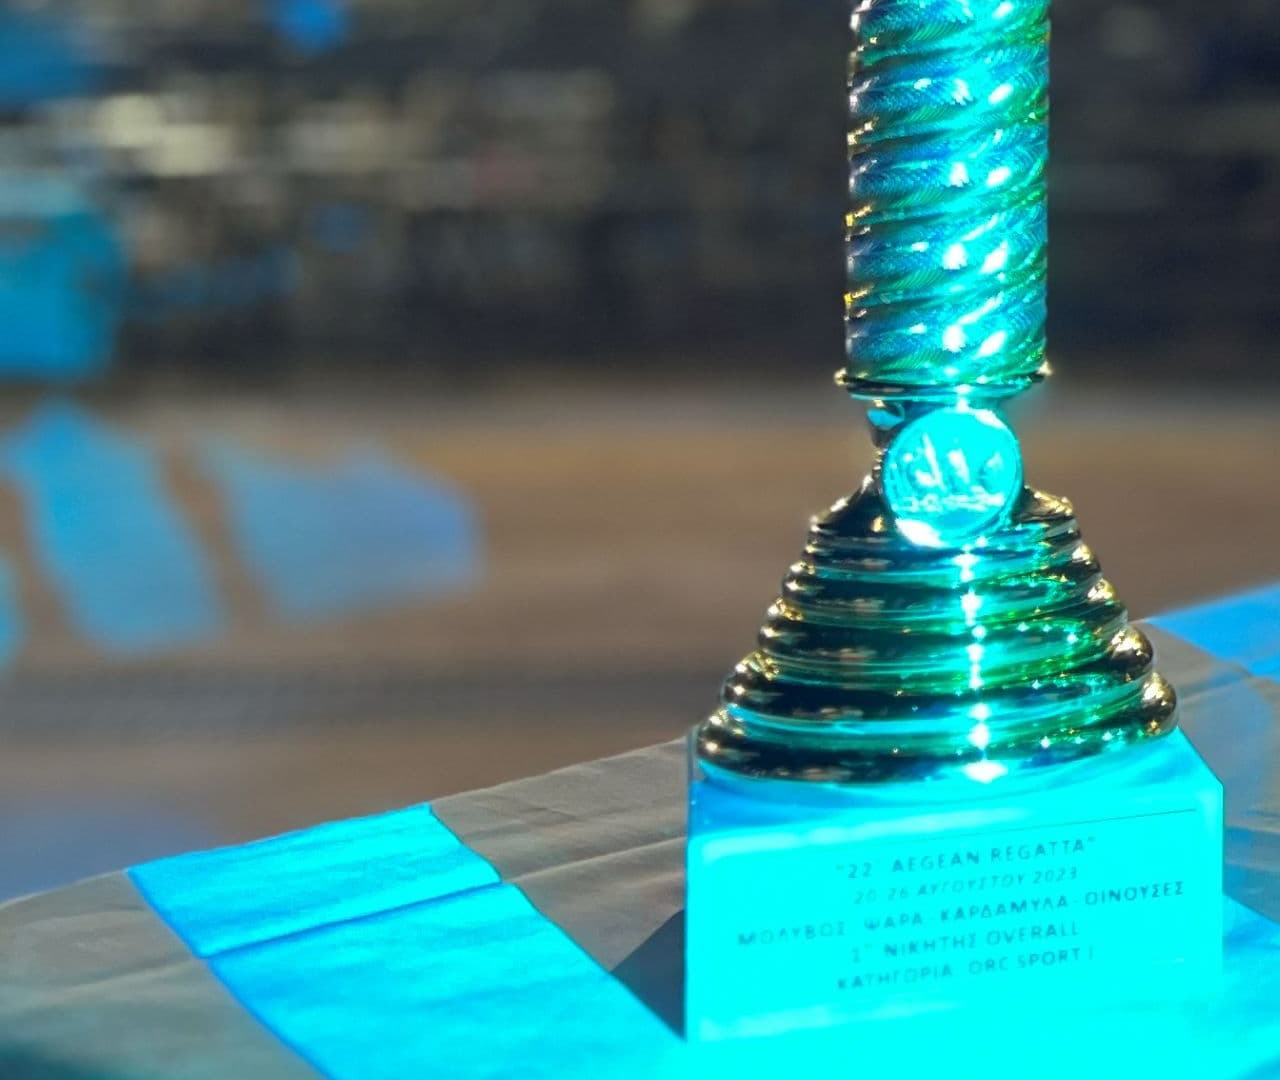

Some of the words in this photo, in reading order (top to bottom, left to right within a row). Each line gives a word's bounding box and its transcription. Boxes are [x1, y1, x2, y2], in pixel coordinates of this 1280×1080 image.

[892, 851, 980, 873] AEGEAN
[1032, 866, 1078, 884] 2023
[986, 920, 1080, 945] OVERALL
[968, 956, 1009, 974] ORC
[1017, 947, 1081, 968] SPORT
